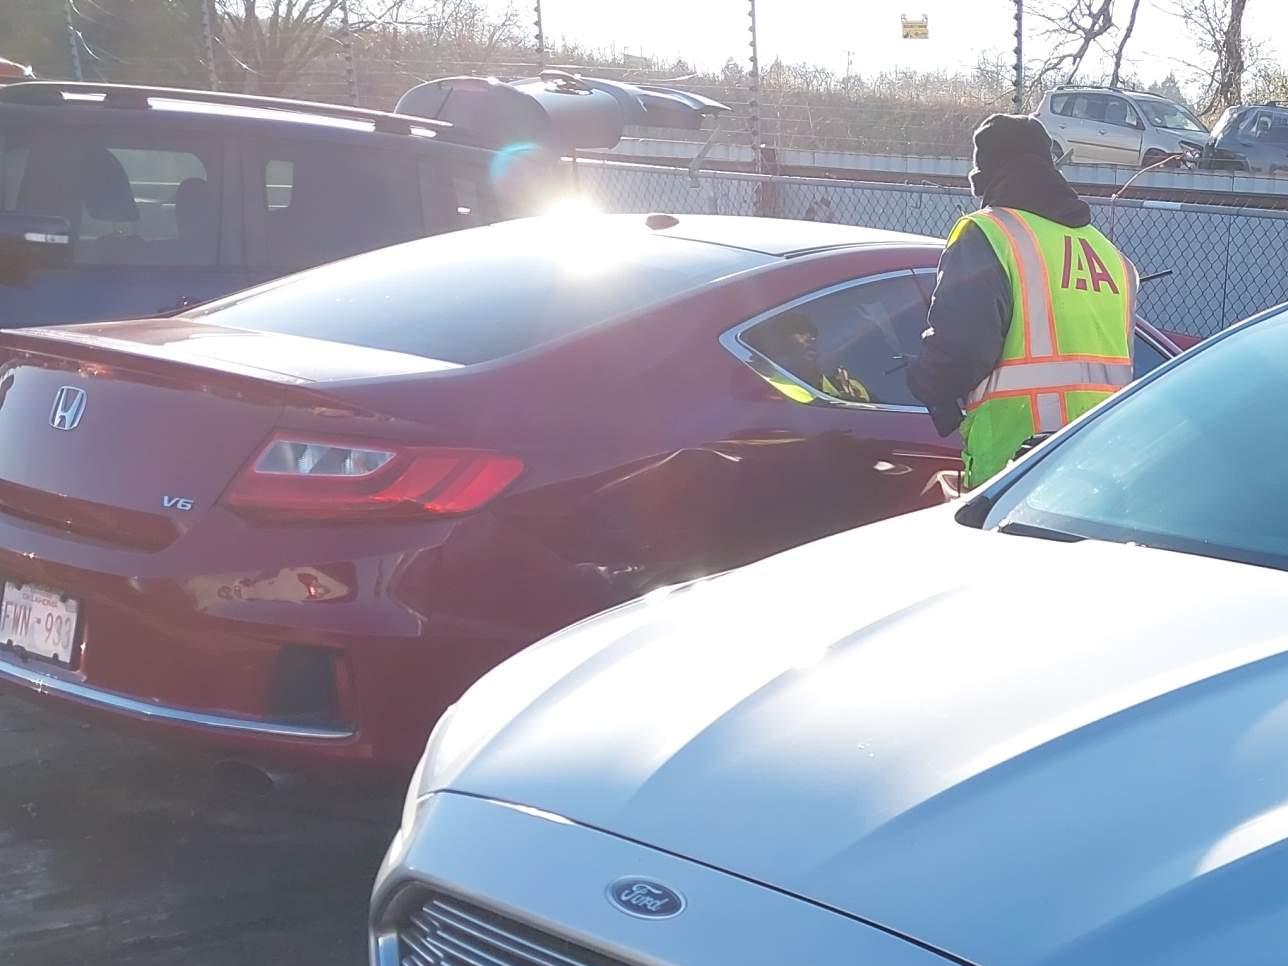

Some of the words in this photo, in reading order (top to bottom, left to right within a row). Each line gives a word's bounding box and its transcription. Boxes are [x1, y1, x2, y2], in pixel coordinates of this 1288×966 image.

[1061, 235, 1120, 295] IAA
[163, 495, 194, 510] V6
[621, 883, 669, 912] Ford
